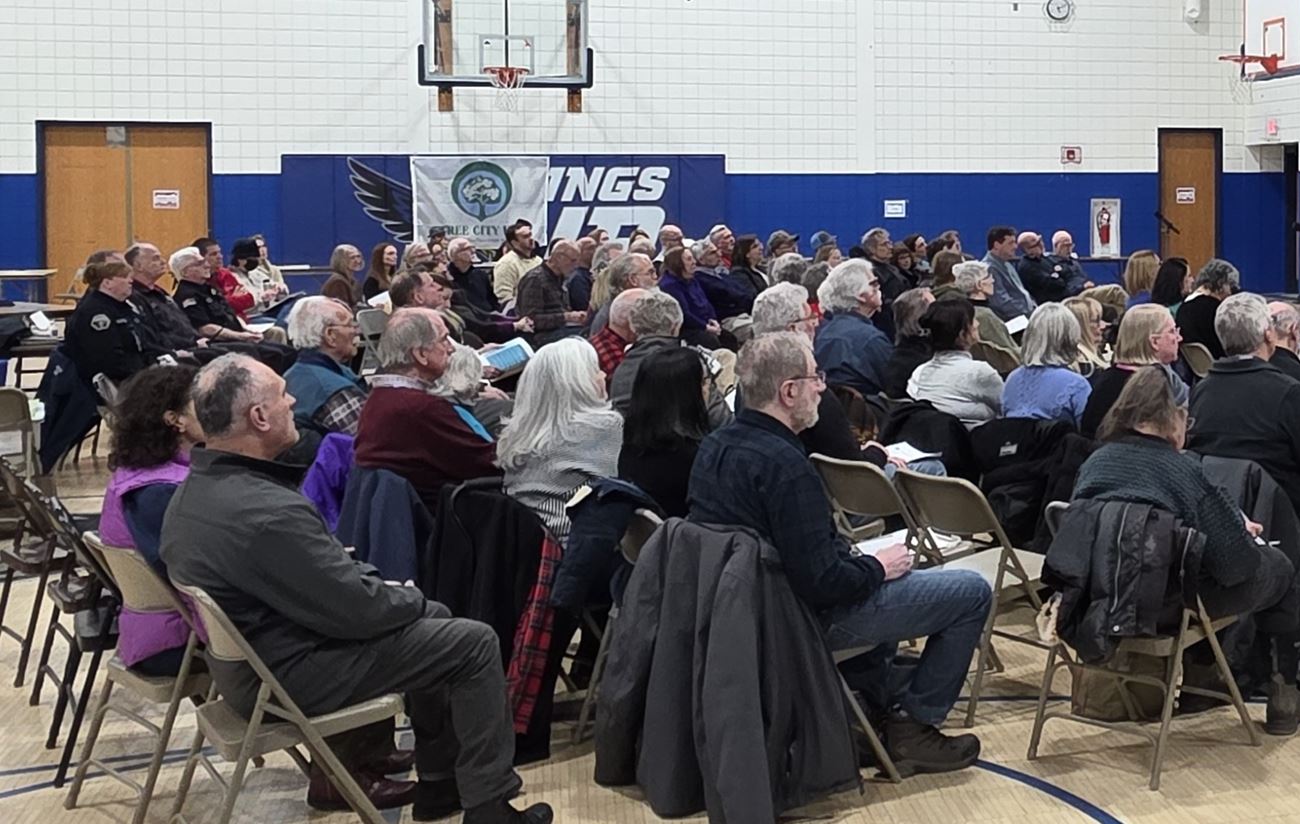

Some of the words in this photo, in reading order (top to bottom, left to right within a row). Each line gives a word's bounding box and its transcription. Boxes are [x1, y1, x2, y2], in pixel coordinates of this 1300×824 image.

[547, 166, 670, 201] INGS
[445, 225, 469, 236] REE
[472, 225, 500, 236] CITY
